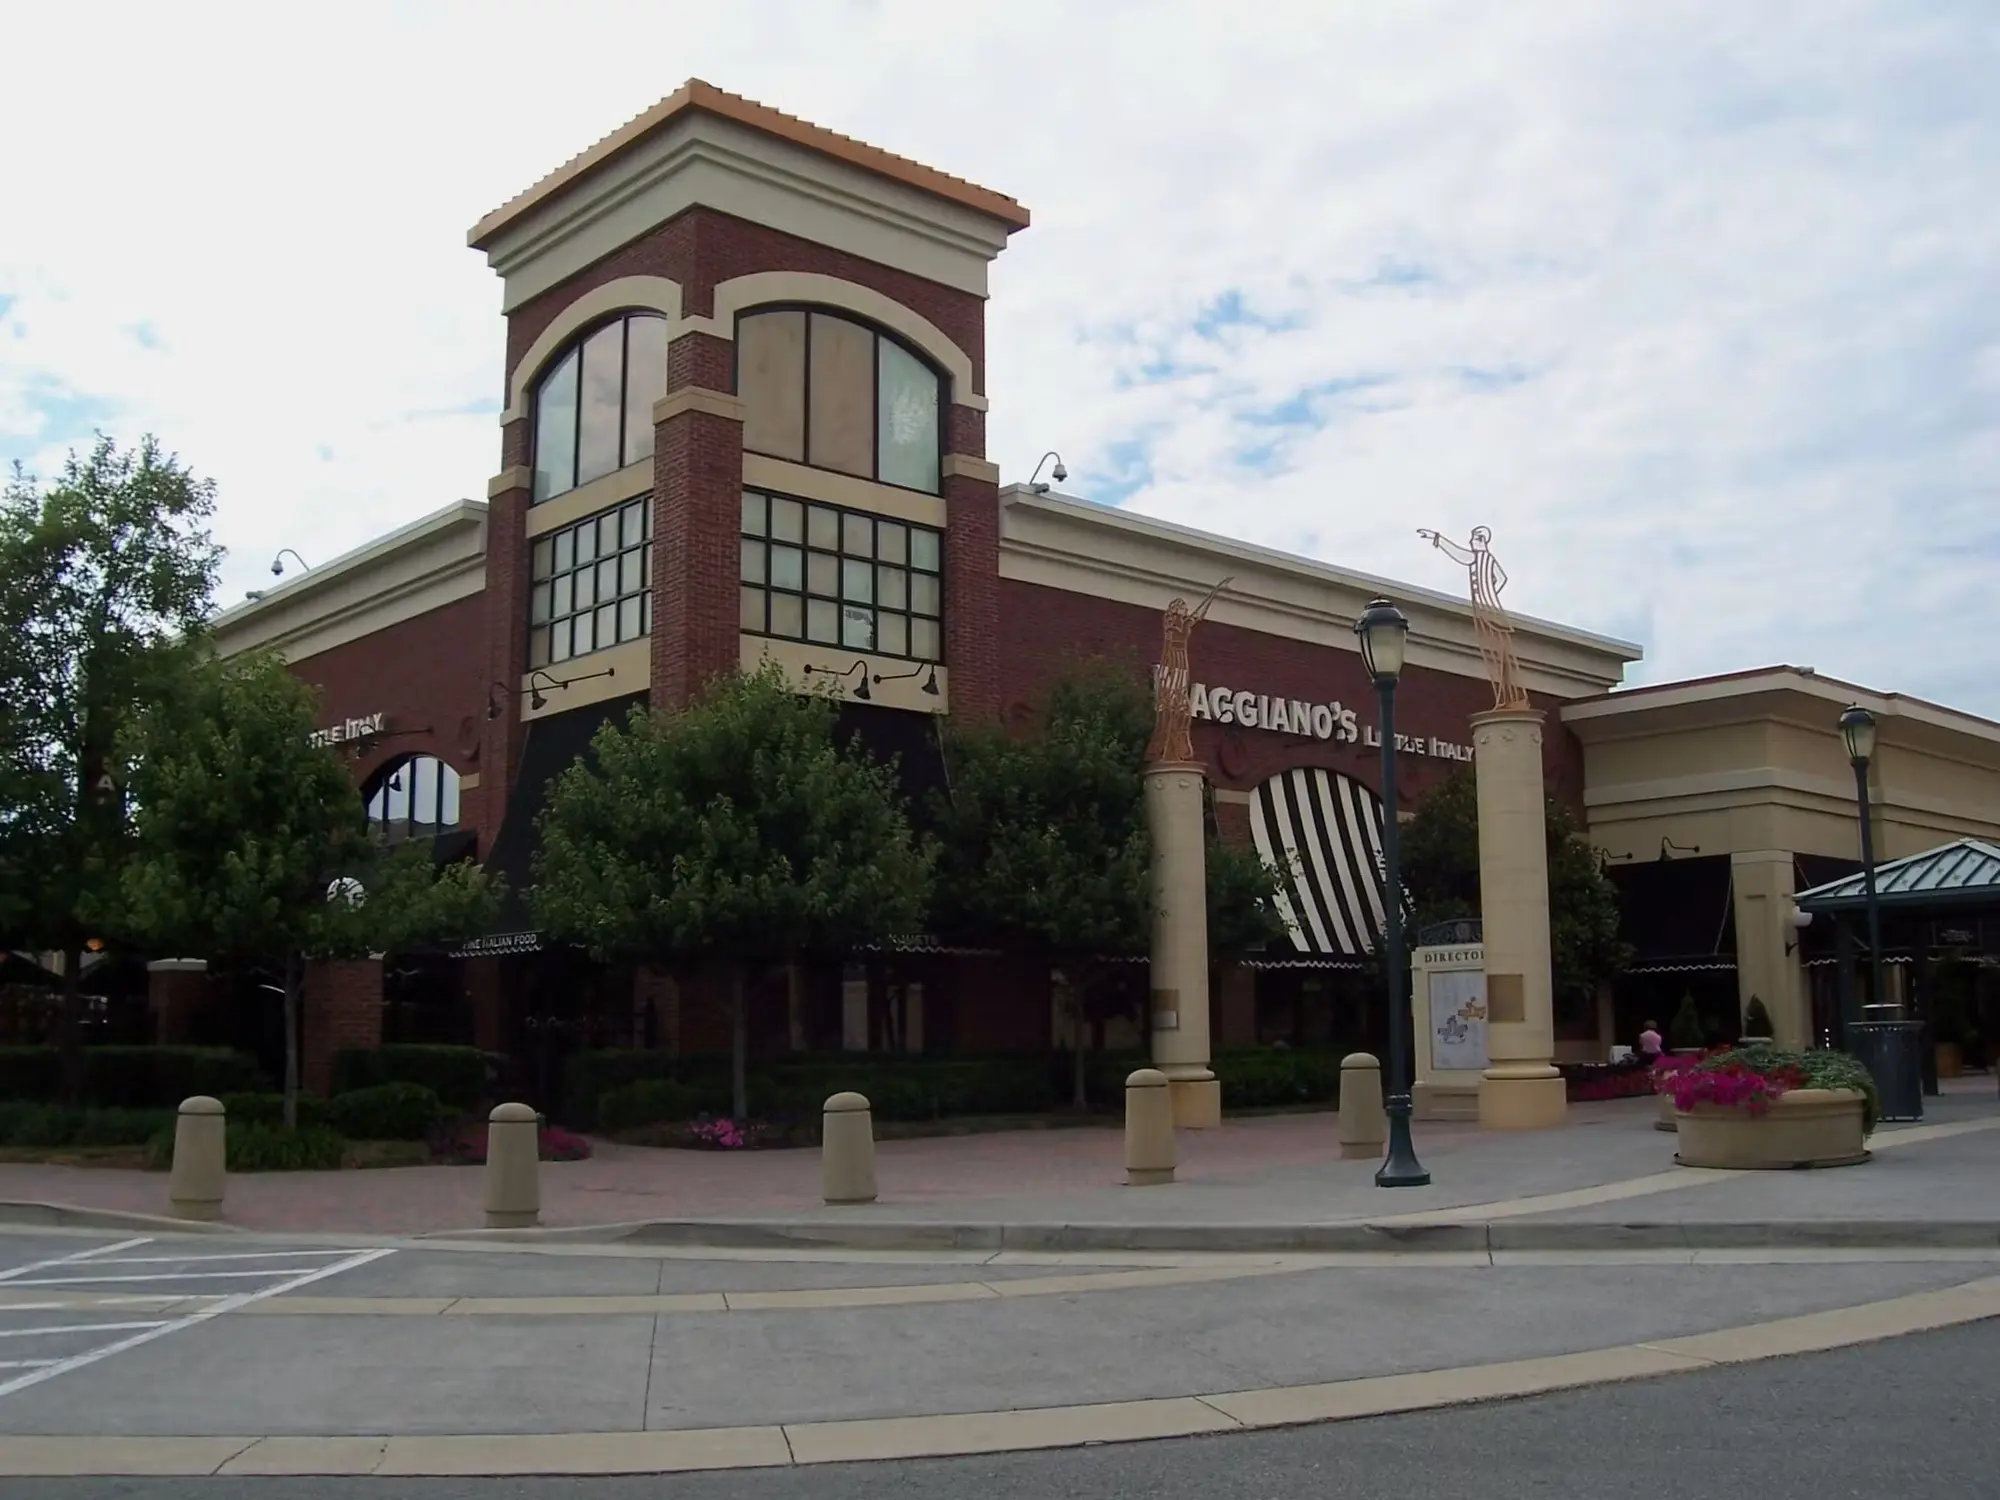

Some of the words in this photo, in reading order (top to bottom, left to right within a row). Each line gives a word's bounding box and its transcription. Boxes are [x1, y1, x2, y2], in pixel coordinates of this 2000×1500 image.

[1428, 736, 1475, 762] ITALY
[514, 933, 537, 945] FOOD
[1424, 950, 1485, 964] DIRECTO
